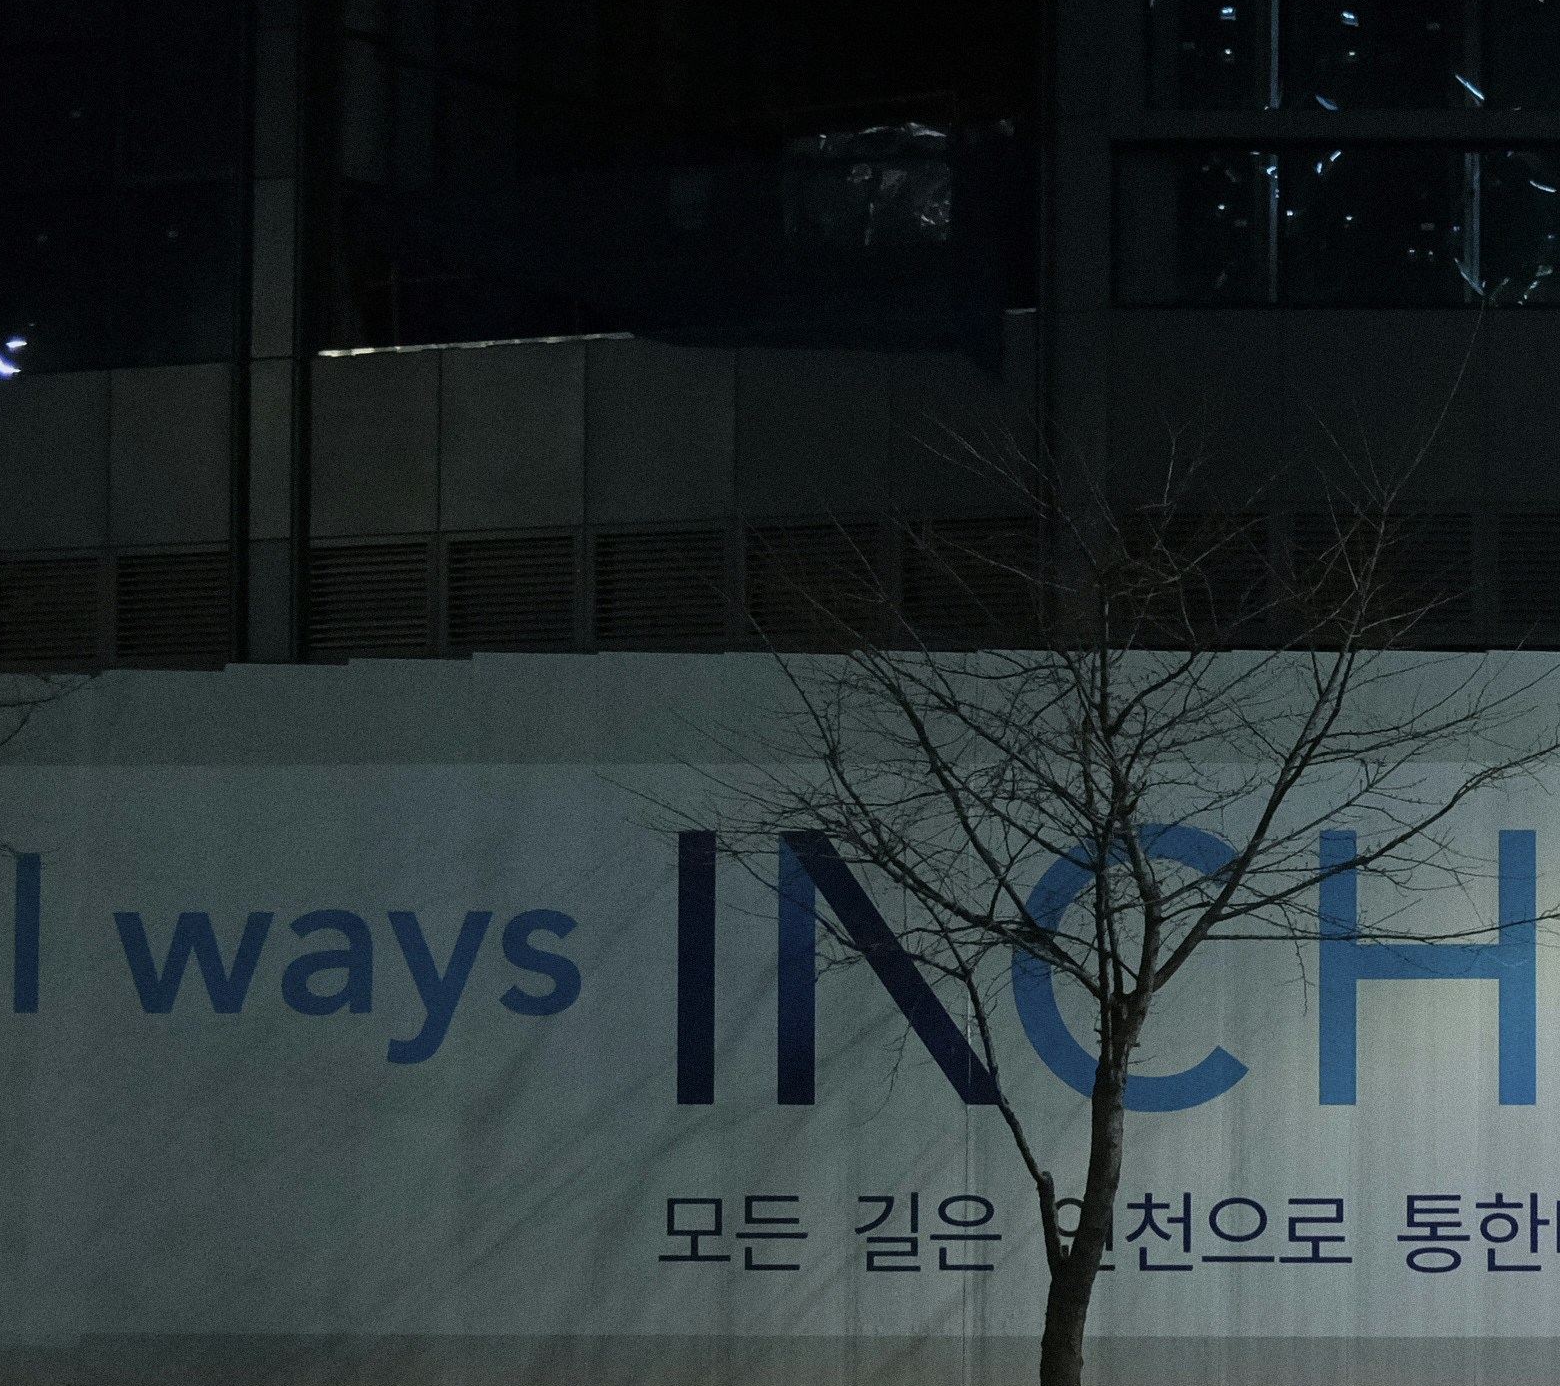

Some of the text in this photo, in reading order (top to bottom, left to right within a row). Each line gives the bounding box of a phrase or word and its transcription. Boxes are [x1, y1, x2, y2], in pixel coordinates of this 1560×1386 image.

[113, 908, 583, 1064] ways
[658, 1196, 808, 1271] 모든
[853, 1194, 1003, 1272] 길은
